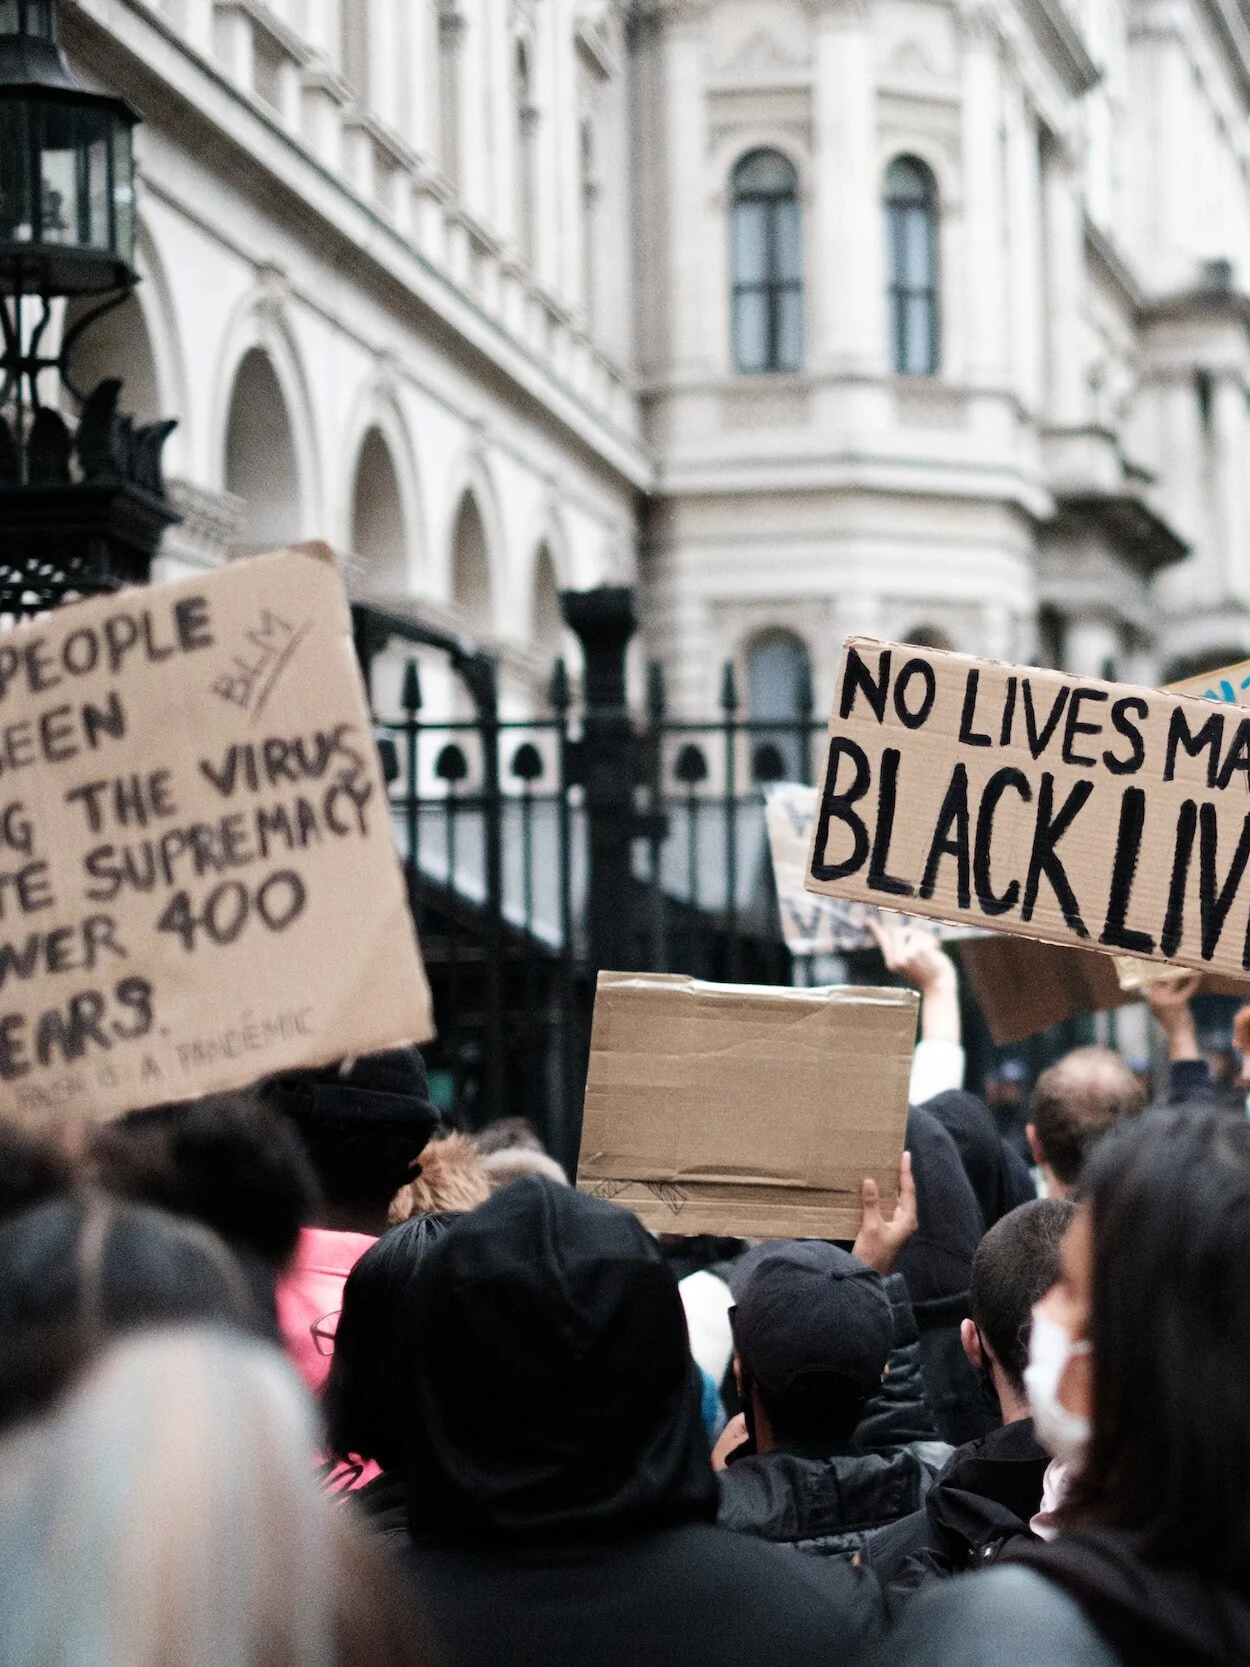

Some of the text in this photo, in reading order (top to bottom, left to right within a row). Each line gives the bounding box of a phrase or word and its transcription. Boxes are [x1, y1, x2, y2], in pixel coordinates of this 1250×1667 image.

[210, 608, 293, 708] BLM
[839, 646, 937, 730] NO
[958, 668, 1149, 775] LIVES
[0, 690, 126, 783] EEN
[64, 767, 177, 834] THE
[200, 723, 366, 797] VIRUS
[84, 778, 373, 901] SUPREMACY
[810, 735, 1092, 939] BLACK
[156, 868, 307, 951] 400
